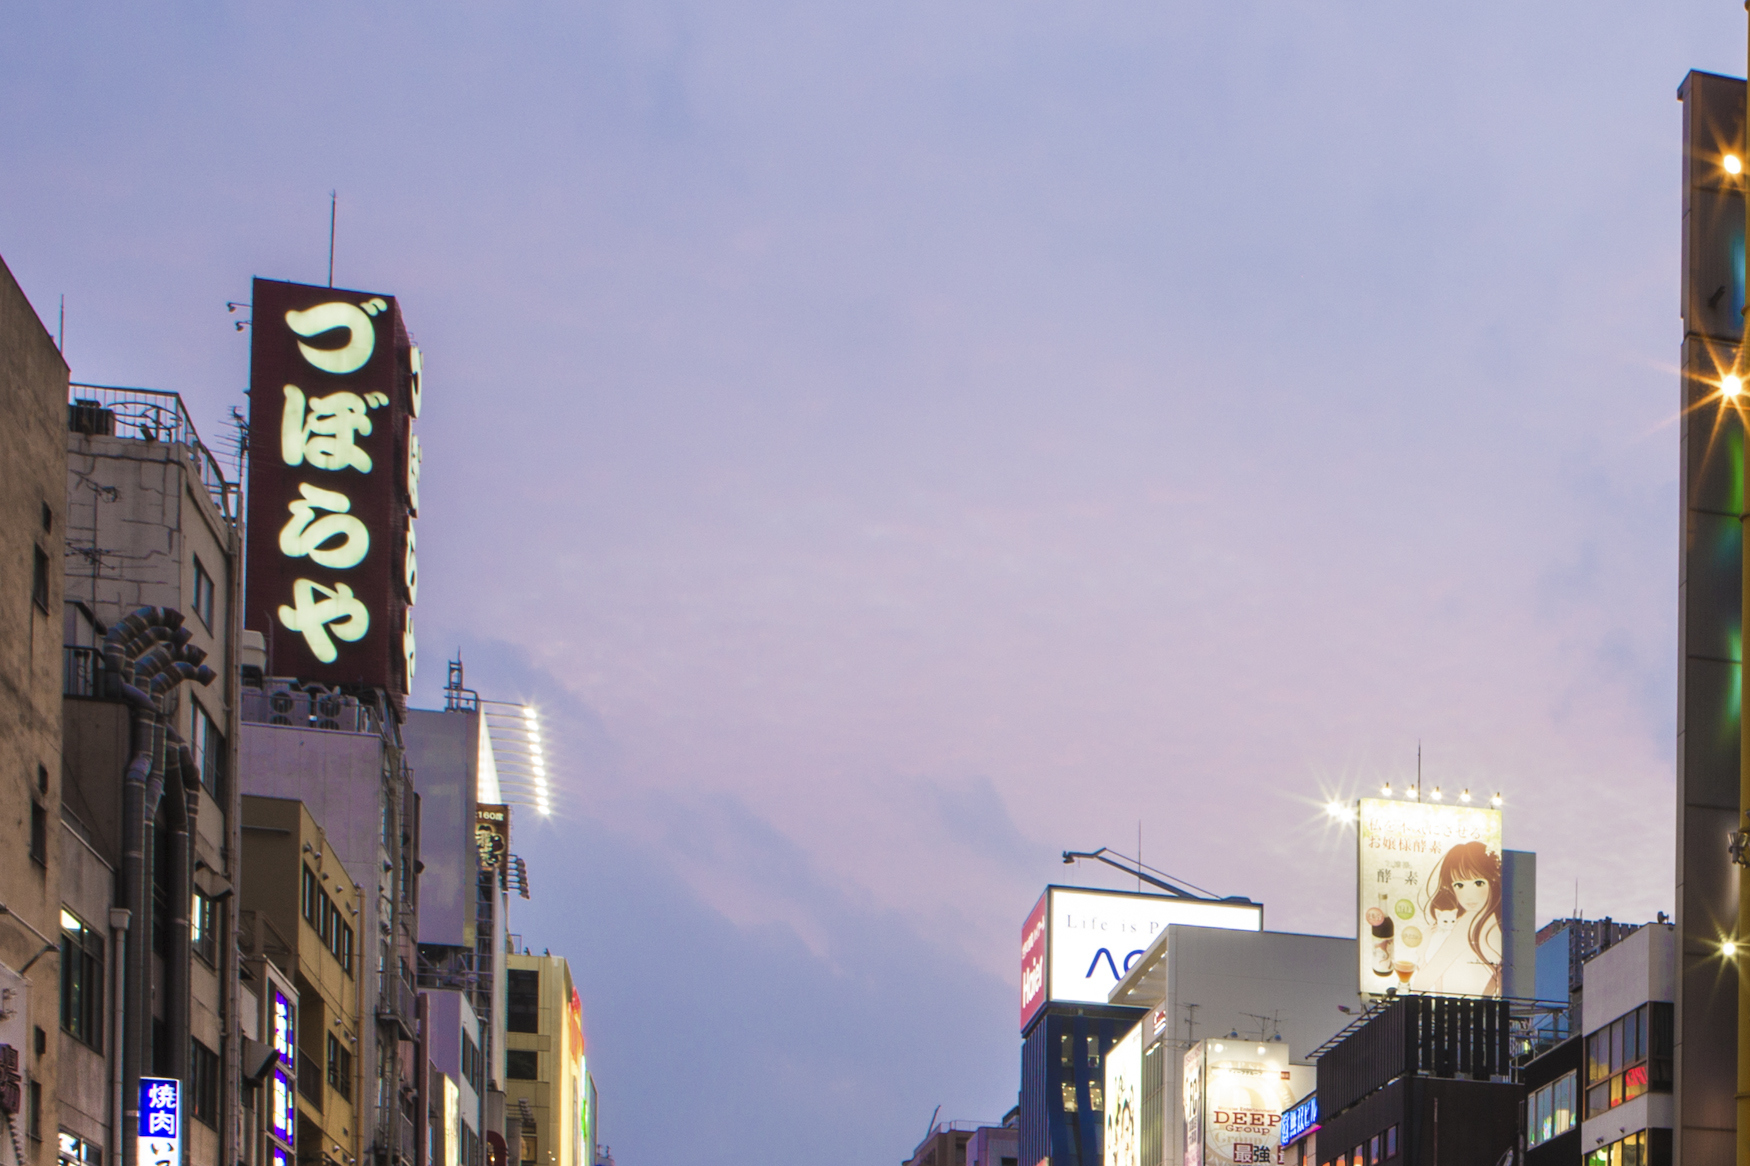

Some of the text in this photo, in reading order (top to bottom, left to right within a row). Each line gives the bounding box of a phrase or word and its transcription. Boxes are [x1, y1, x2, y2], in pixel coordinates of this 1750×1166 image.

[278, 297, 391, 664] づぼらや
[1067, 914, 1109, 932] Life
[1121, 919, 1137, 933] is
[1022, 955, 1044, 1009] Haier
[148, 1083, 177, 1135] 焼肉
[1213, 1110, 1282, 1127] DEEP
[1225, 1124, 1271, 1136] Group
[1233, 1143, 1271, 1164] 最強
